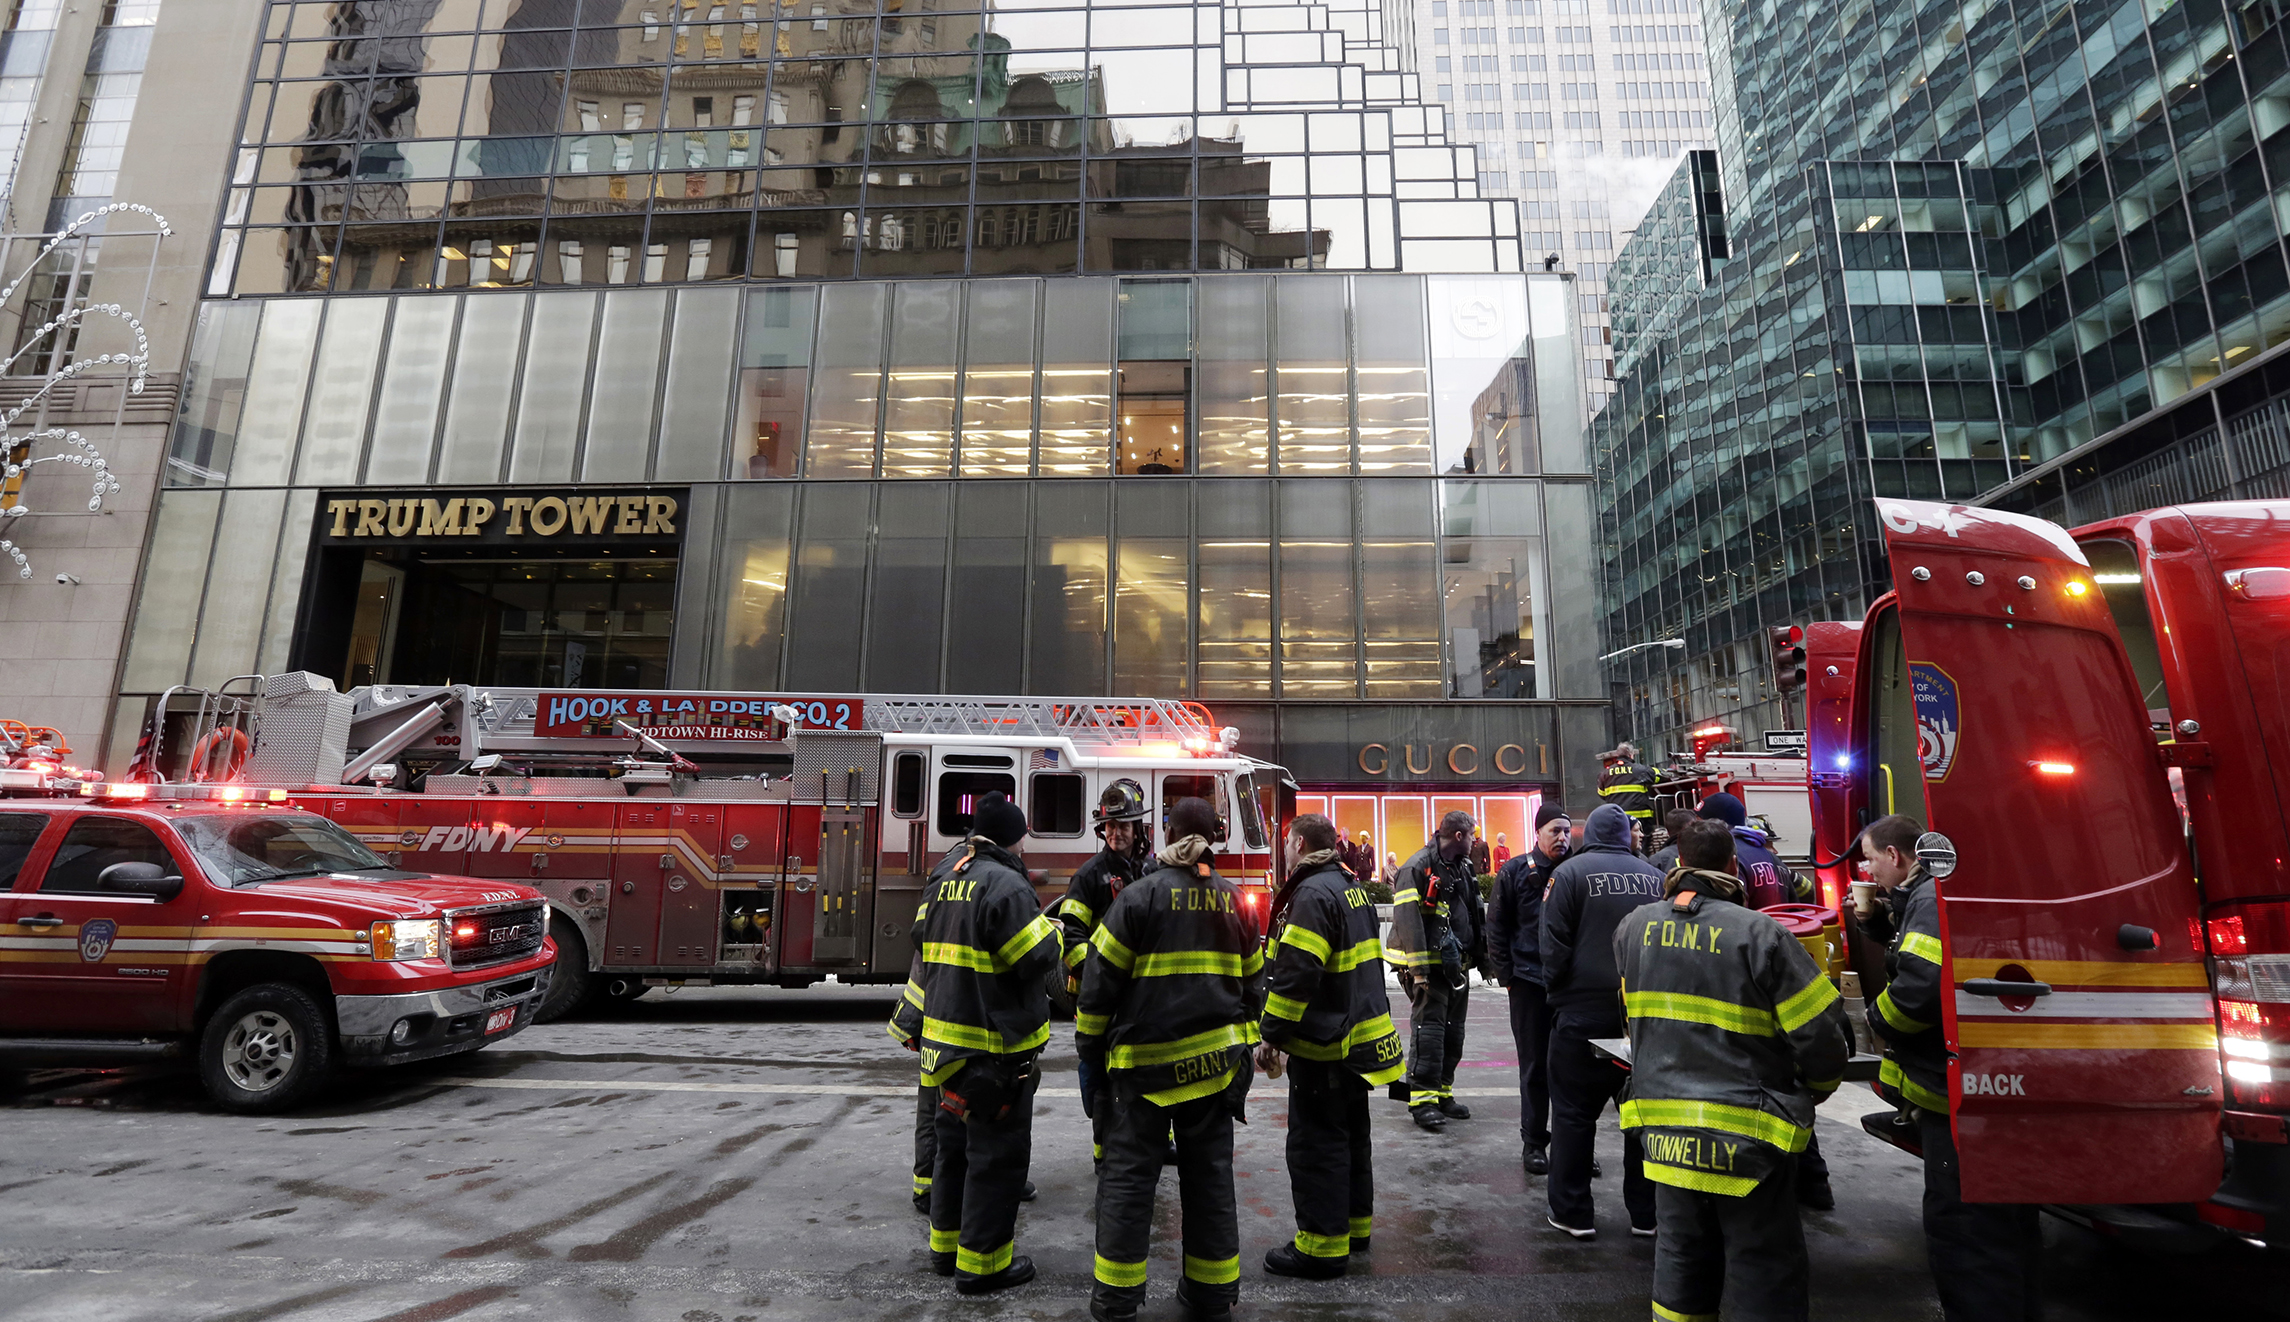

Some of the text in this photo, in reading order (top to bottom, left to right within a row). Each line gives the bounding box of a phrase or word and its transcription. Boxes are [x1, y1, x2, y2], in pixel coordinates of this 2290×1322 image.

[327, 495, 678, 537] TRUMP TOWER
[1916, 683, 1929, 692] OF
[548, 697, 629, 727] HOOK
[635, 698, 653, 713] &
[434, 735, 461, 746] 100
[710, 727, 769, 739] HI-RISE
[1772, 736, 1789, 744] ONE
[1358, 743, 1548, 776] GUCCI
[418, 825, 532, 853] FDNY
[1585, 872, 1660, 897] FDNY
[489, 925, 528, 944] GMC
[508, 1009, 516, 1025] 3
[1174, 1048, 1229, 1084] GRANT
[1962, 1073, 2026, 1096] BACK
[1646, 1133, 1738, 1171] DONNELLY
